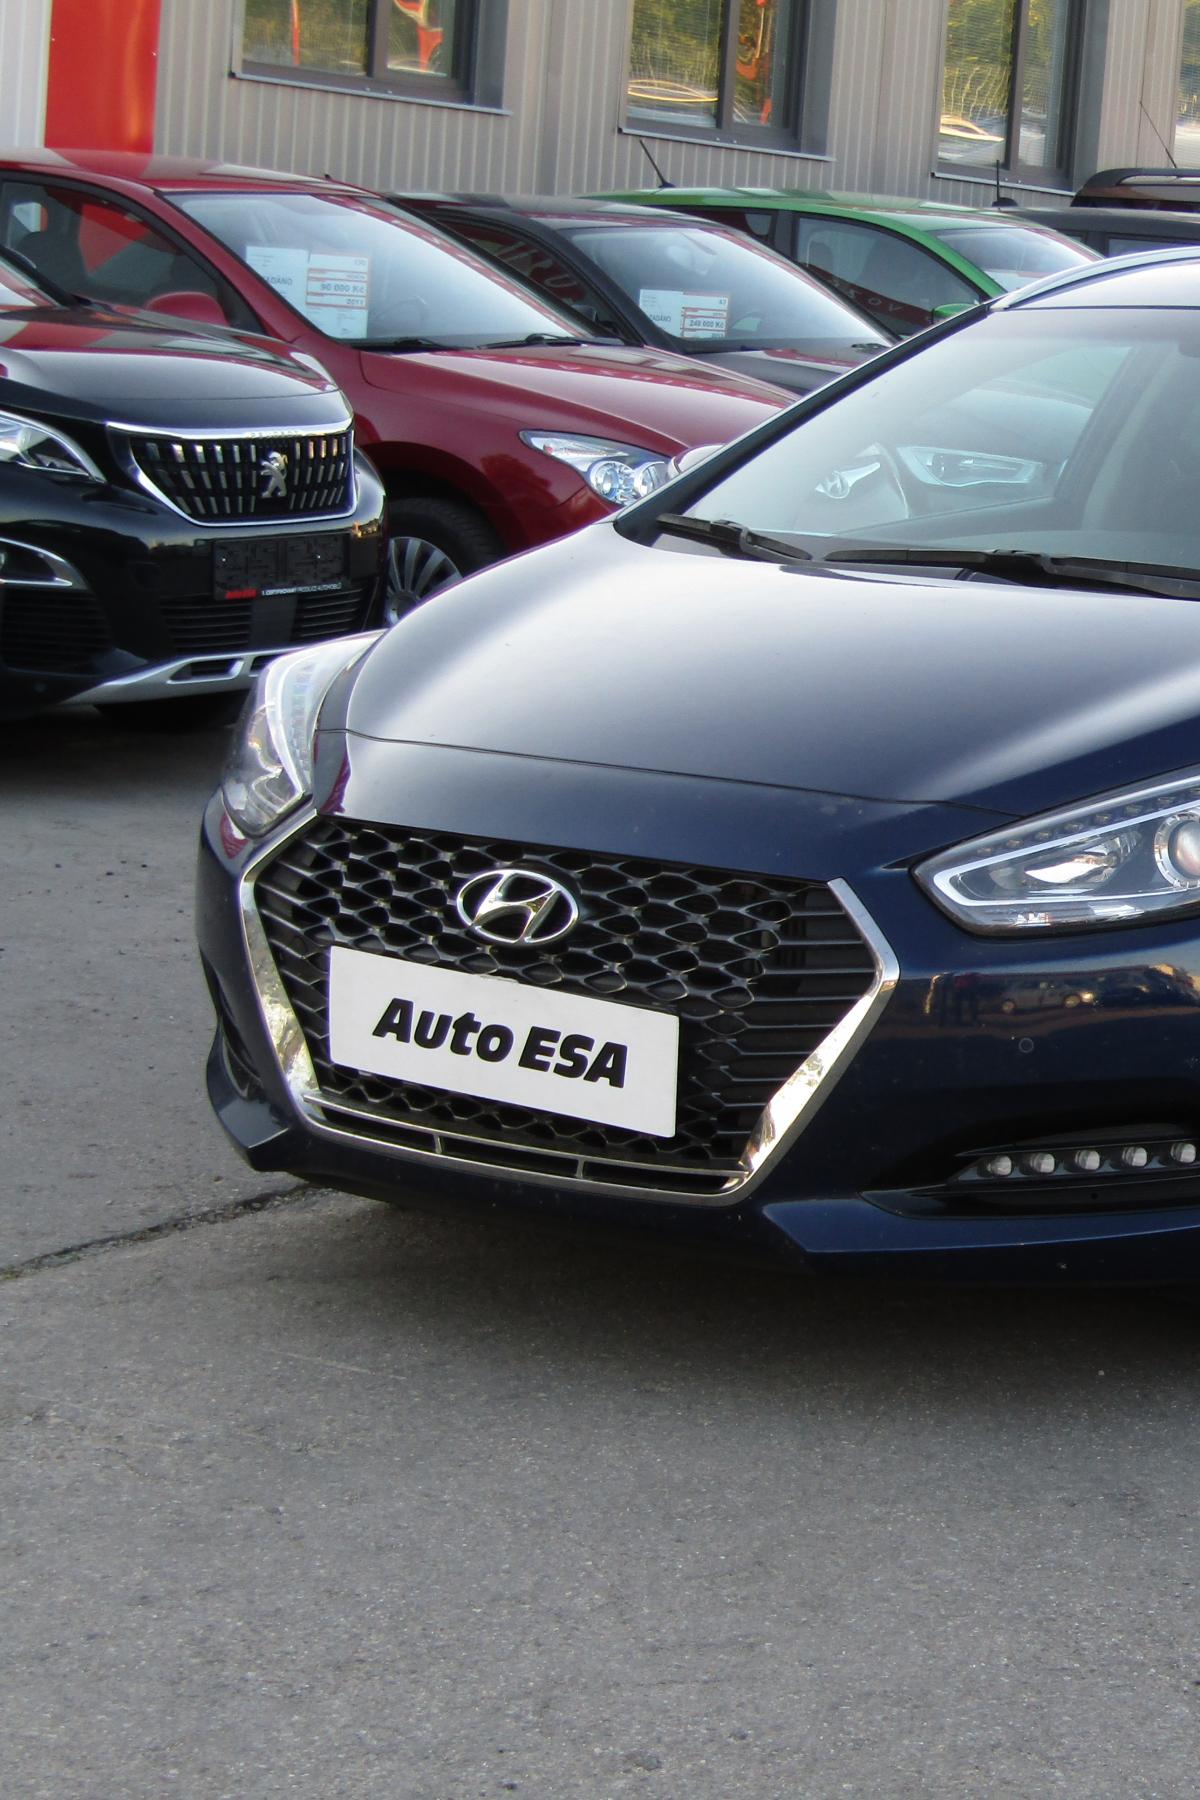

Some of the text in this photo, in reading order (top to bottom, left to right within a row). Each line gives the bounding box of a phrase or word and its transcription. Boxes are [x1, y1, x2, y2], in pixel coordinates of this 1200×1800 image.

[703, 320, 714, 328] 000
[372, 998, 628, 1088] Auto ESA
